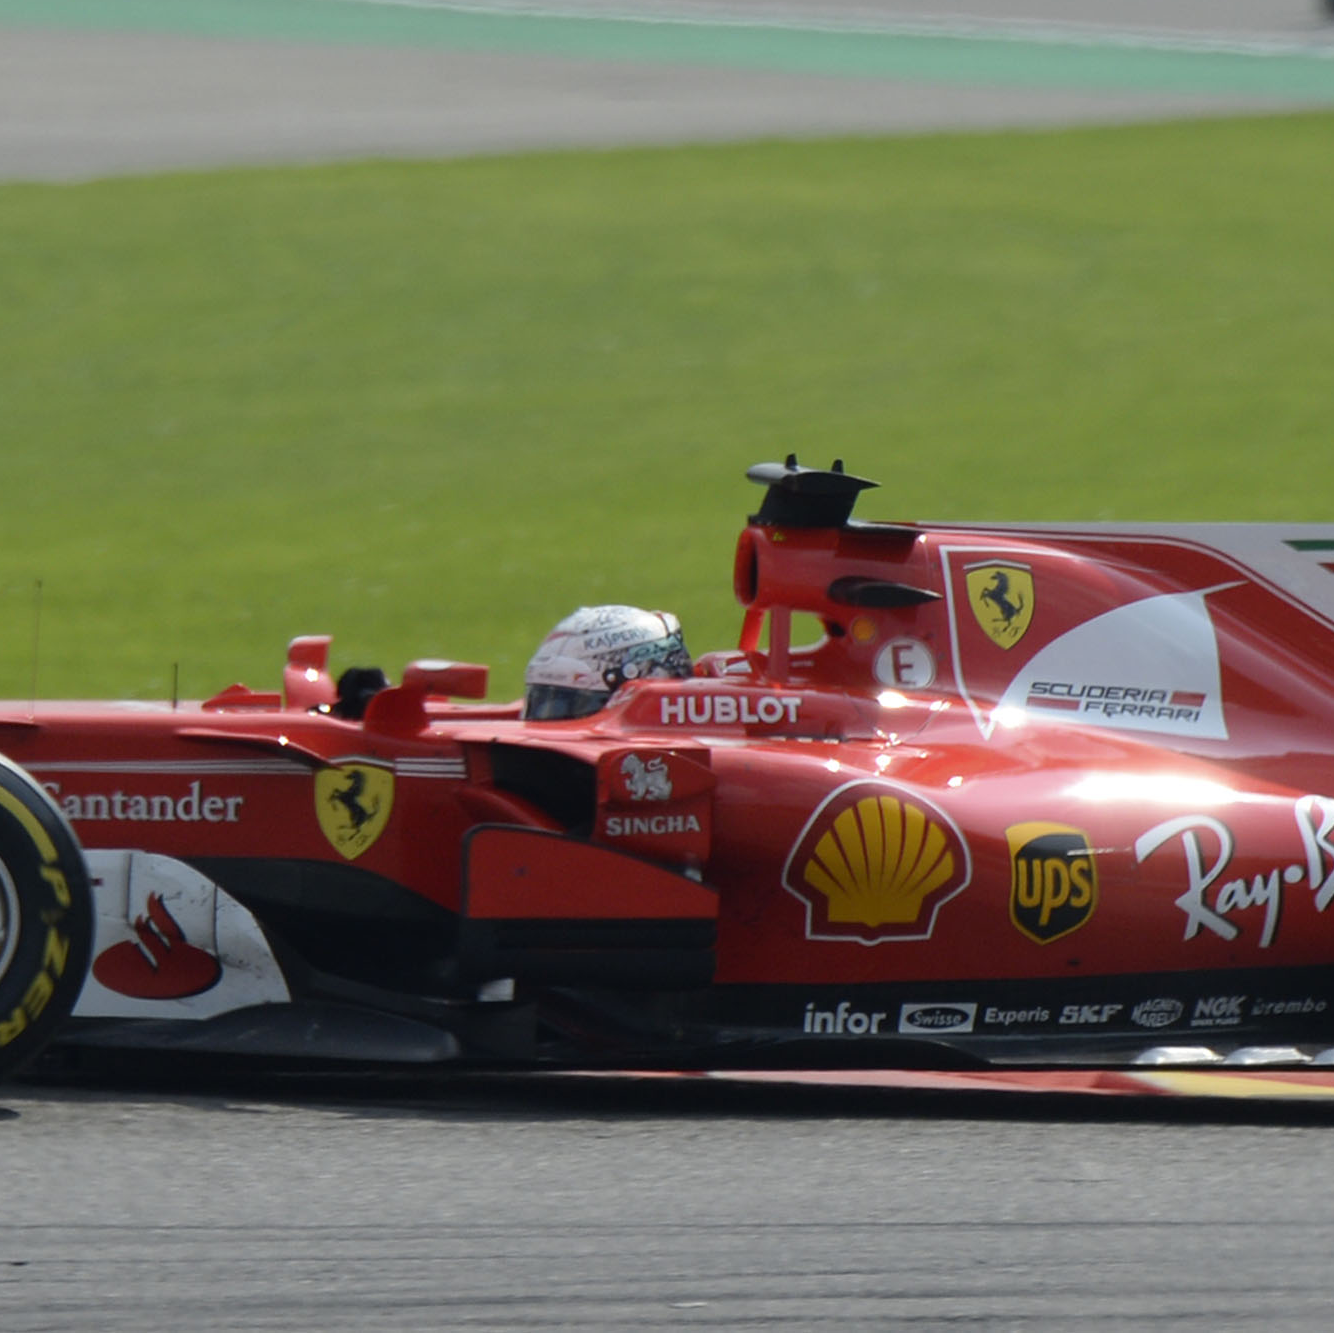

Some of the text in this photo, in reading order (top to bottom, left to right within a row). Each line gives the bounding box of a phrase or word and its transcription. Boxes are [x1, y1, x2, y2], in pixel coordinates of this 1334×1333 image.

[890, 645, 918, 686] E
[1029, 681, 1167, 703] SCUDERIA
[660, 696, 802, 724] HUBLOT
[1084, 700, 1202, 723] FERRARI
[606, 813, 701, 836] SINGHA
[1017, 856, 1094, 927] ups
[803, 1002, 887, 1034] infor
[913, 1010, 963, 1026] Swisse
[984, 1006, 1050, 1026] Experis
[1059, 1004, 1123, 1024] SKF
[1194, 995, 1247, 1018] NGK
